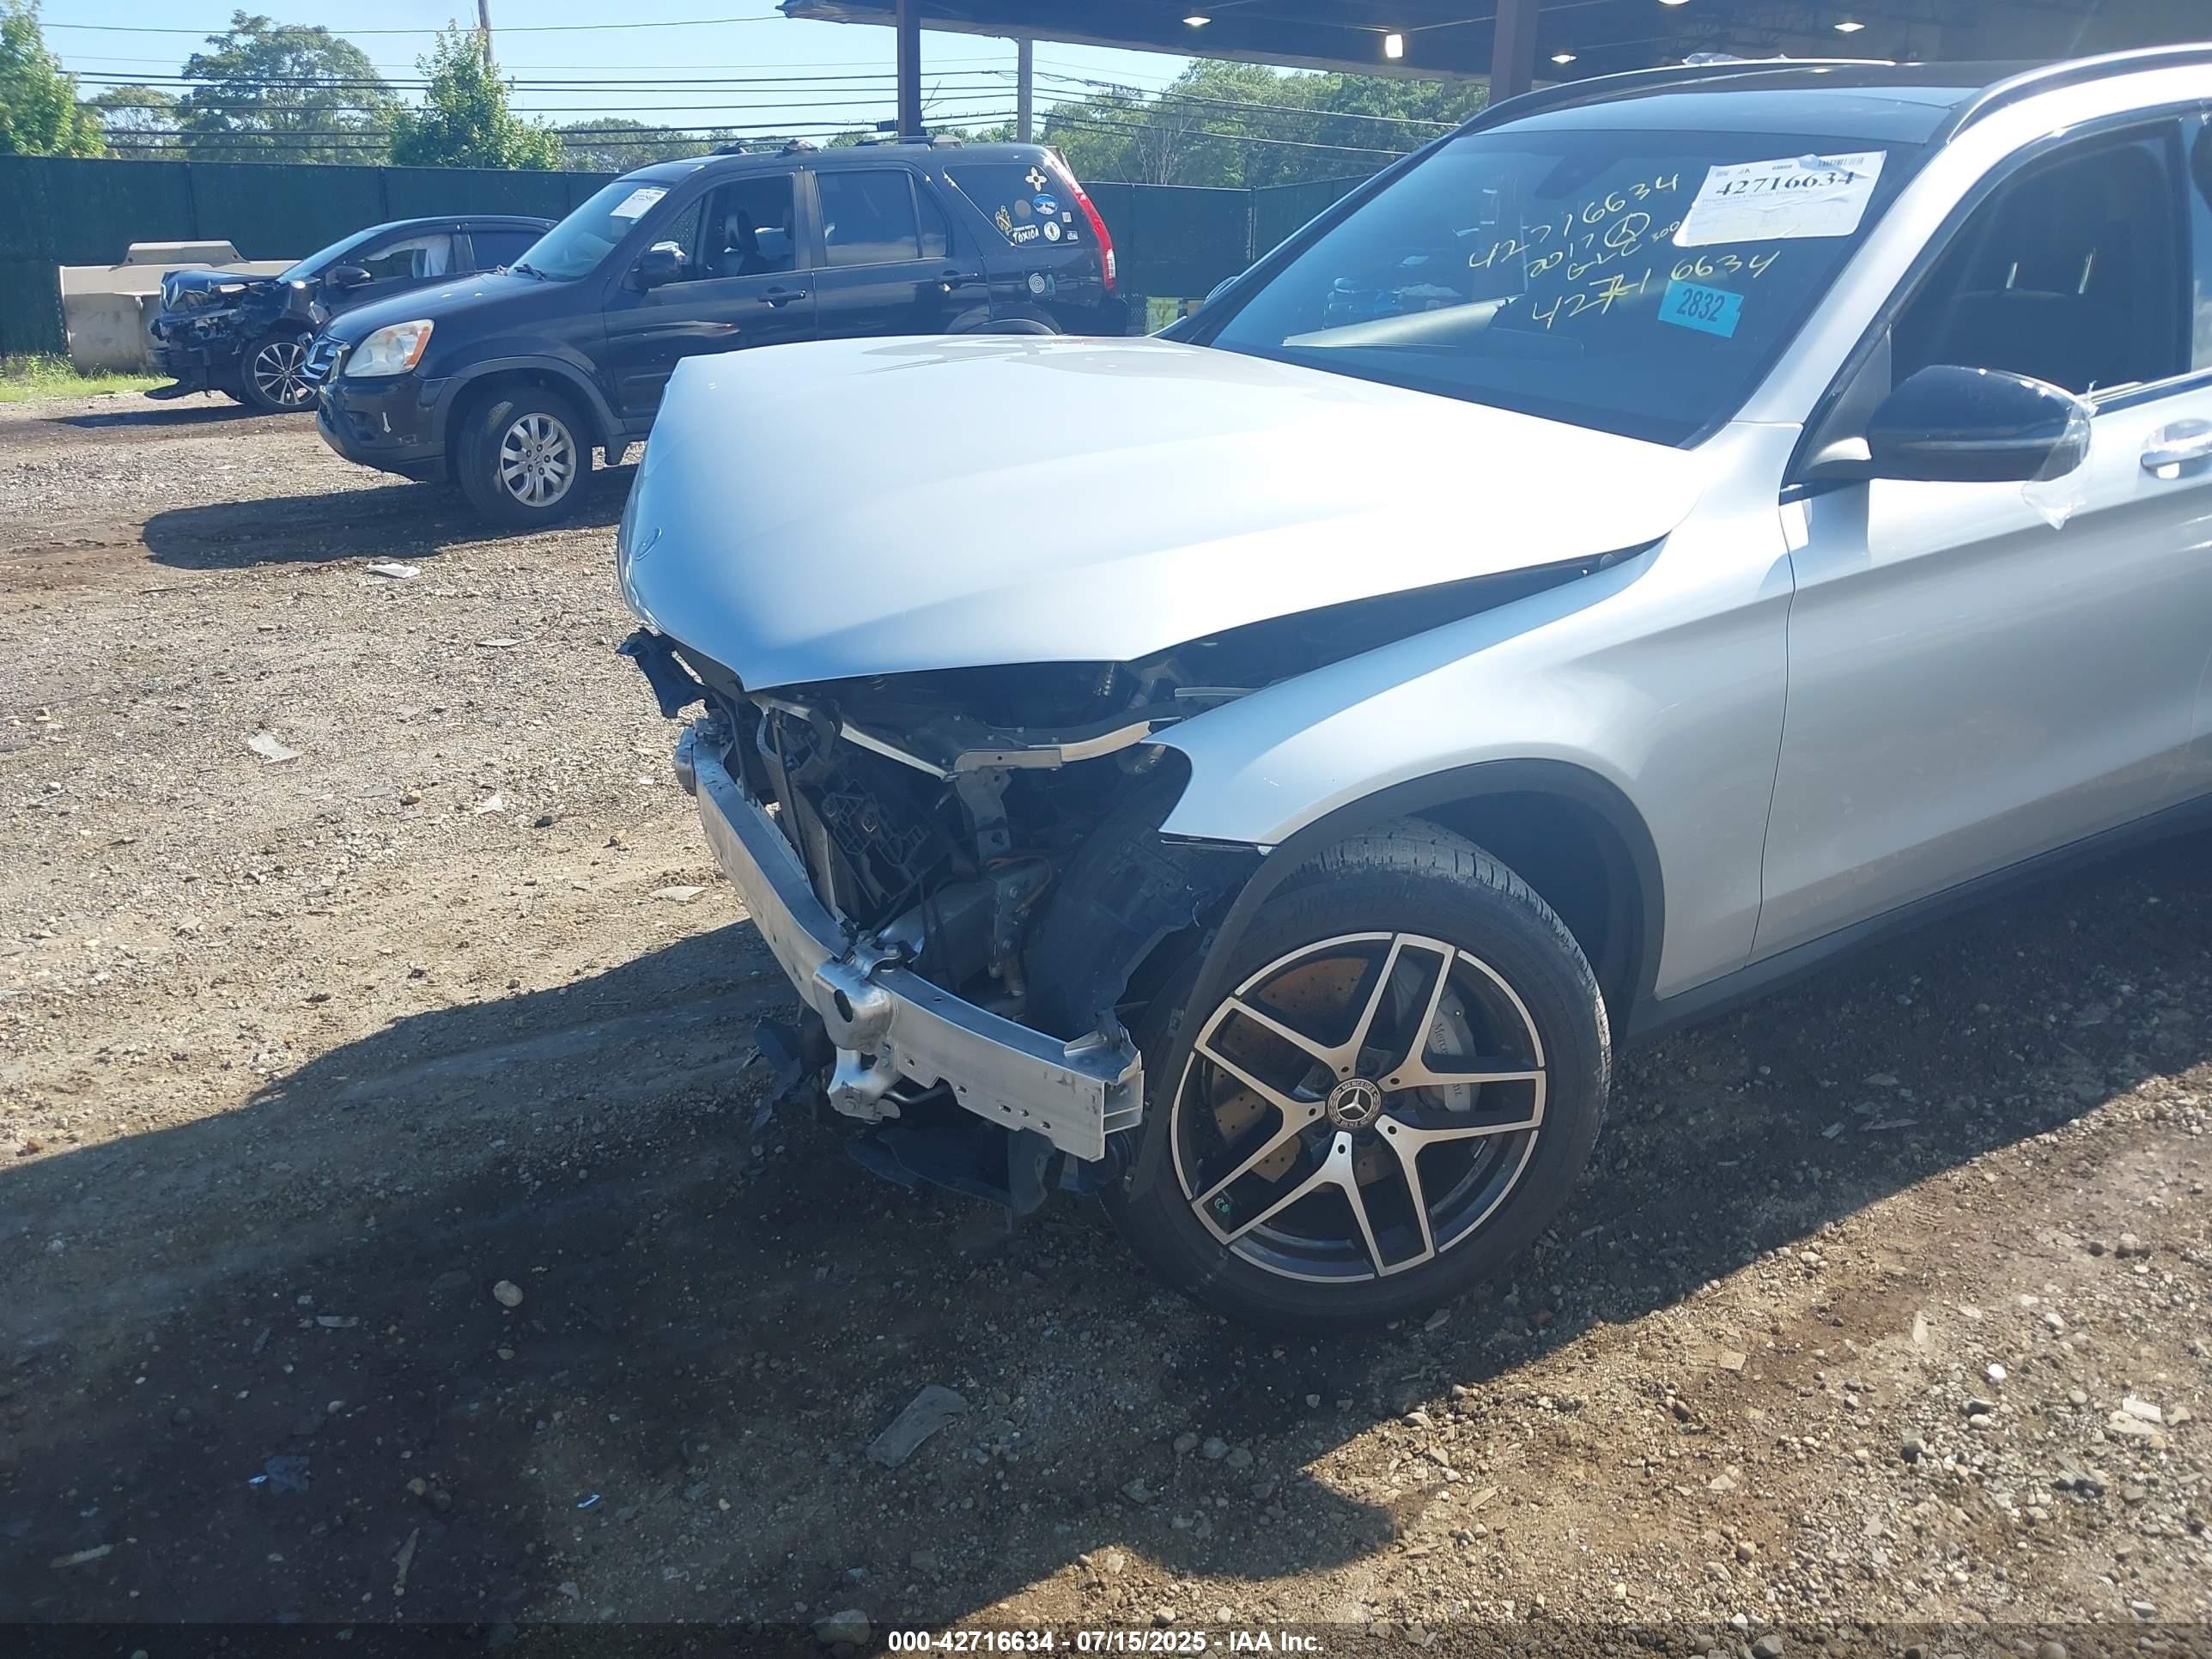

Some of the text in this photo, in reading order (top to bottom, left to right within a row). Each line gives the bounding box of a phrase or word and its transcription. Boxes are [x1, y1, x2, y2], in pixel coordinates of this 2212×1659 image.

[1716, 172, 1855, 197] 42716634
[1469, 173, 1680, 268] 42716634
[1524, 233, 1595, 278] 2017
[1676, 288, 1725, 322] 2832
[1341, 1081, 1376, 1093] MERCEDES
